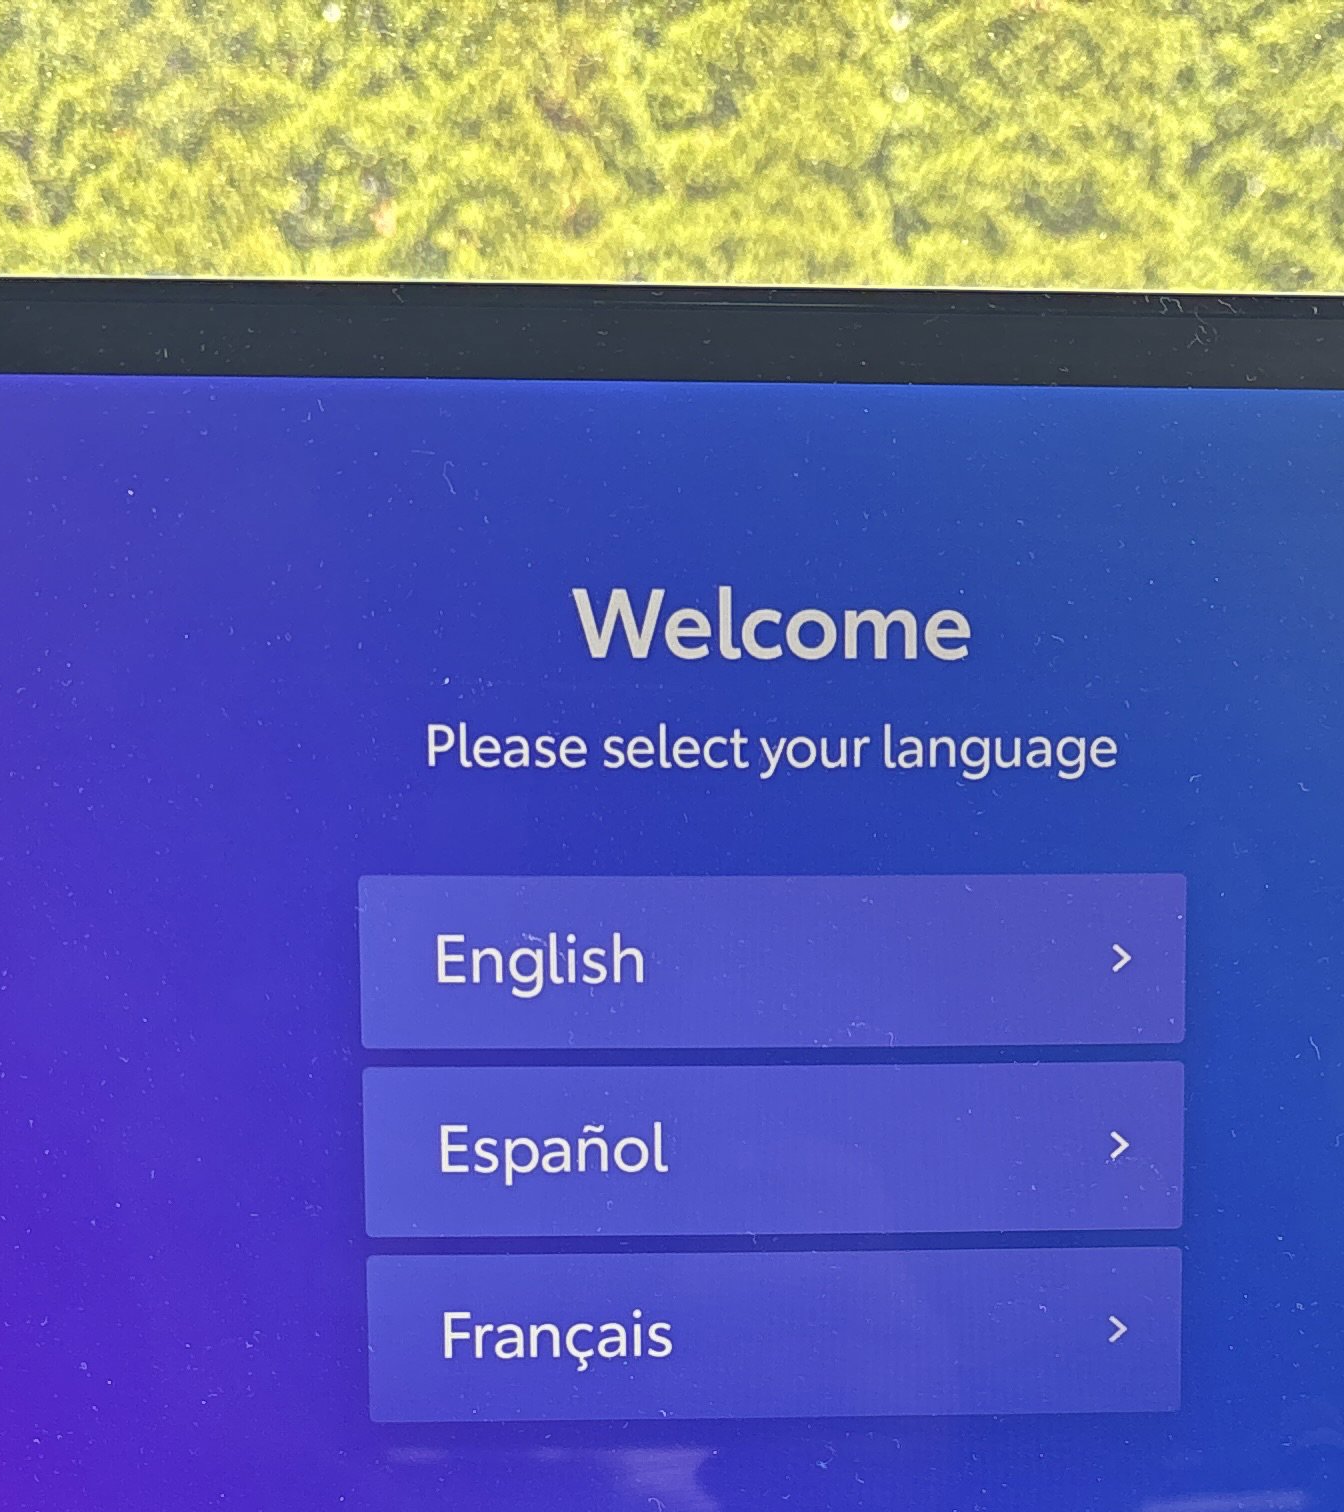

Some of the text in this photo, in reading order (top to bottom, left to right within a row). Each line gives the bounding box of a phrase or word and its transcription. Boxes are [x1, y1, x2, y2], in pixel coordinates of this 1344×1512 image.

[572, 585, 972, 661] Welcome
[427, 724, 1119, 780] Please select your language
[436, 933, 646, 998] English
[439, 1122, 669, 1185] Español
[442, 1309, 674, 1371] Français
